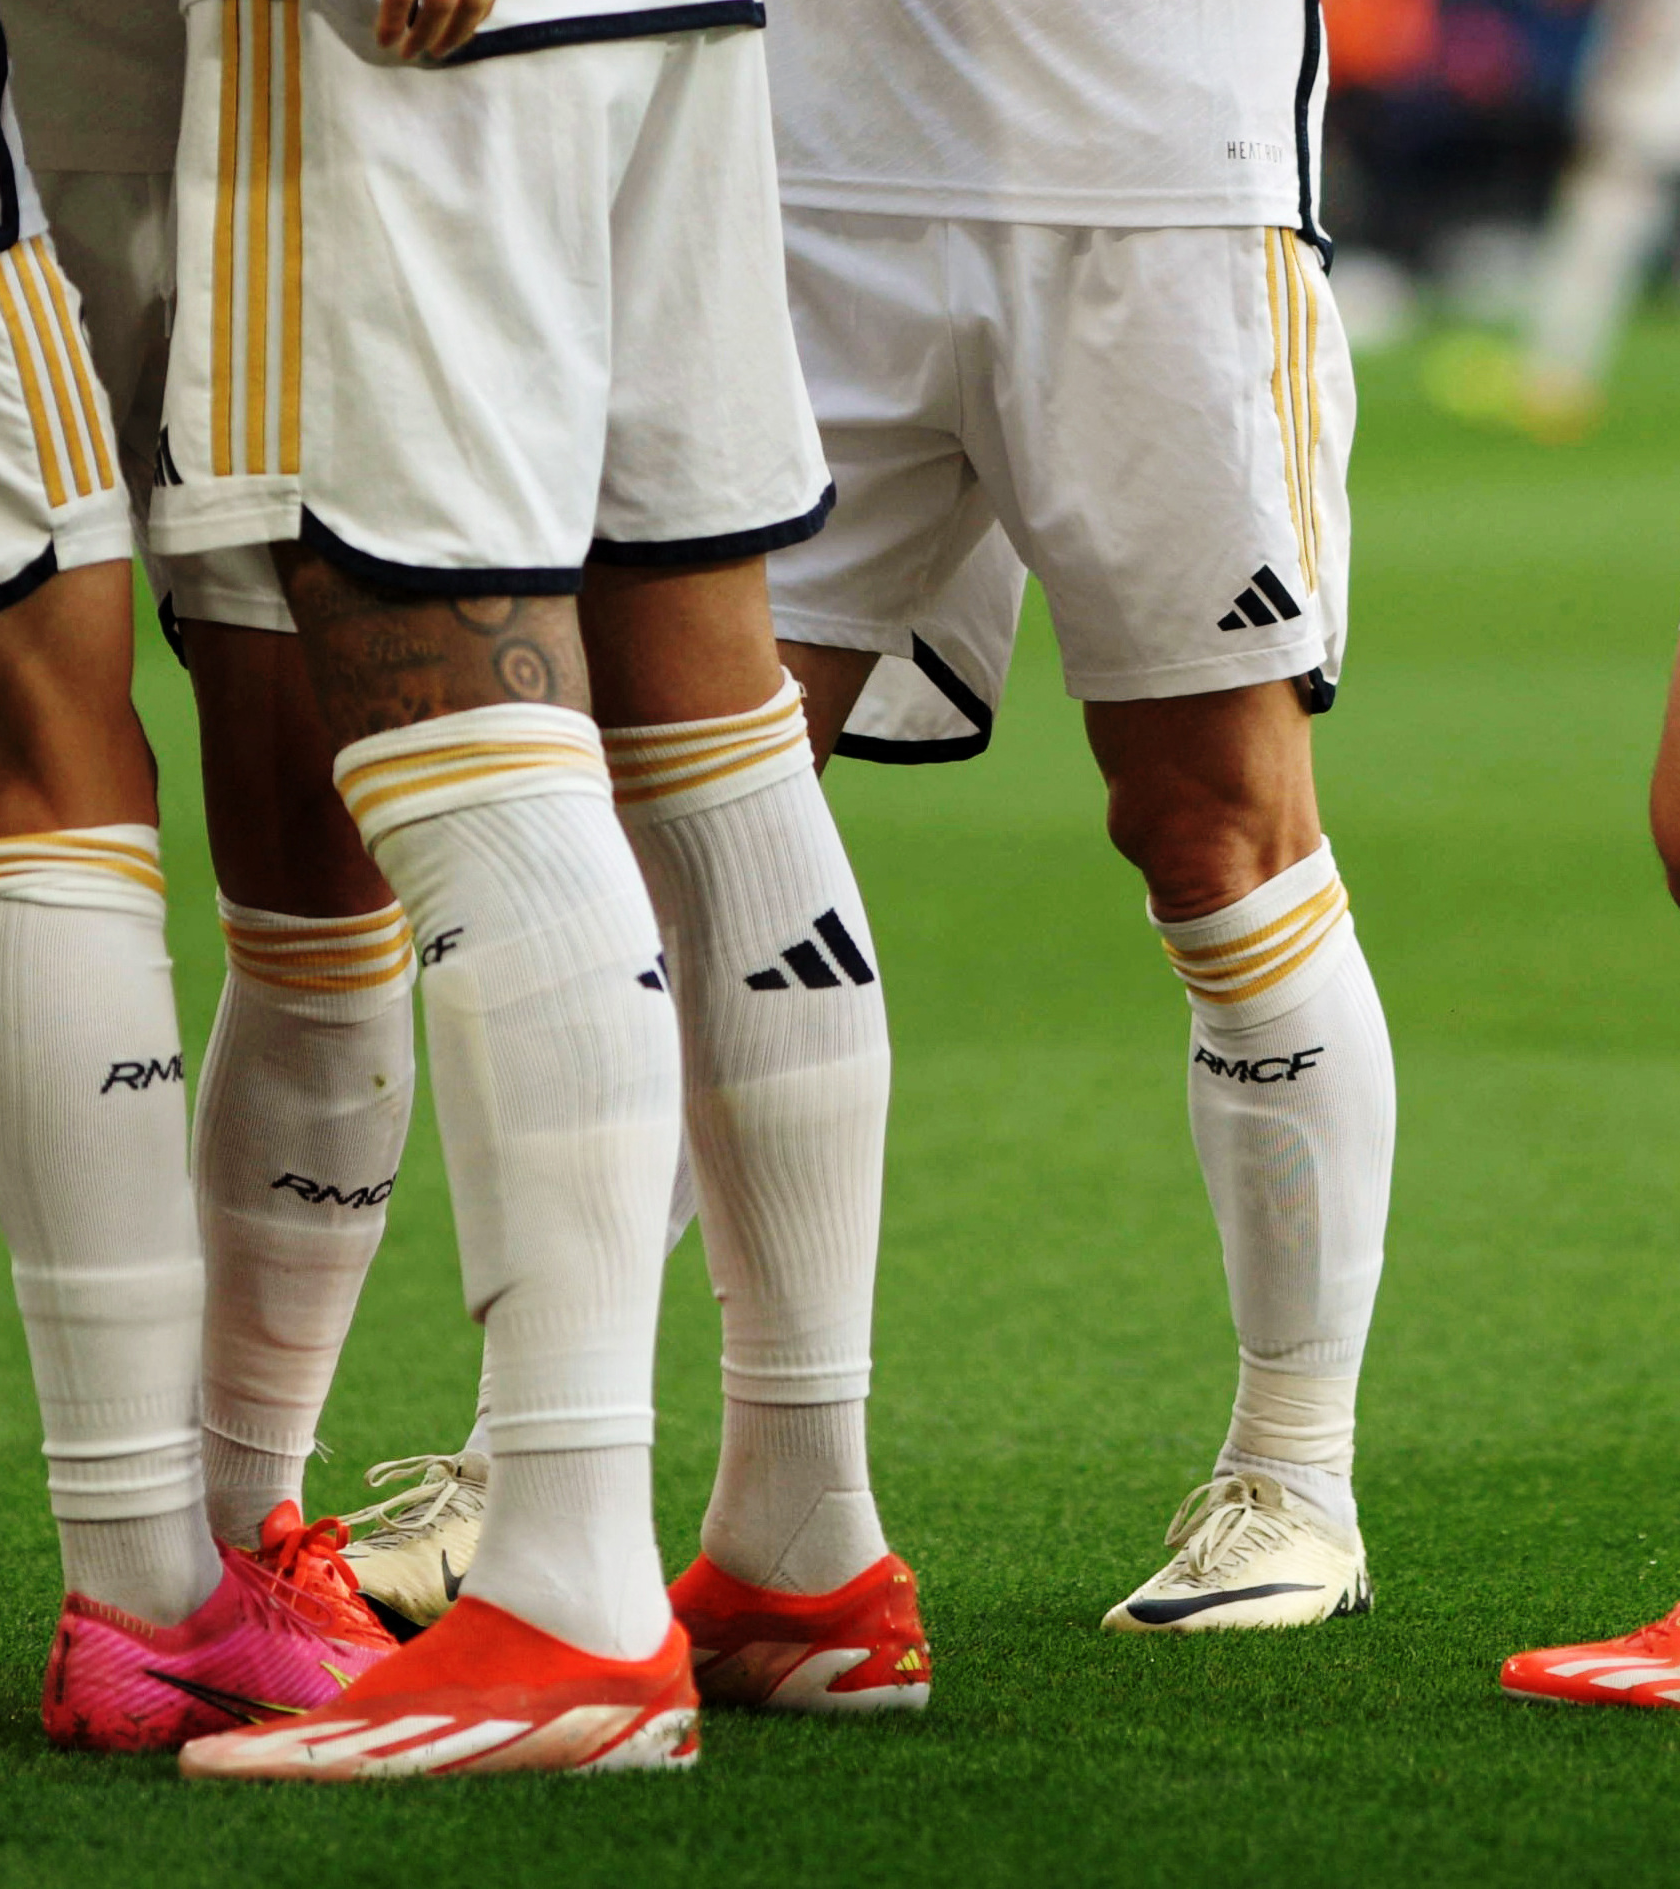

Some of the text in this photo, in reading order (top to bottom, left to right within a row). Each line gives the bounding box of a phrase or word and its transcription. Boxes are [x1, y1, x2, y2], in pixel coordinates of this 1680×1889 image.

[100, 1052, 184, 1095] RM
[1193, 1045, 1324, 1084] RMCF
[270, 1171, 397, 1210] RMC
